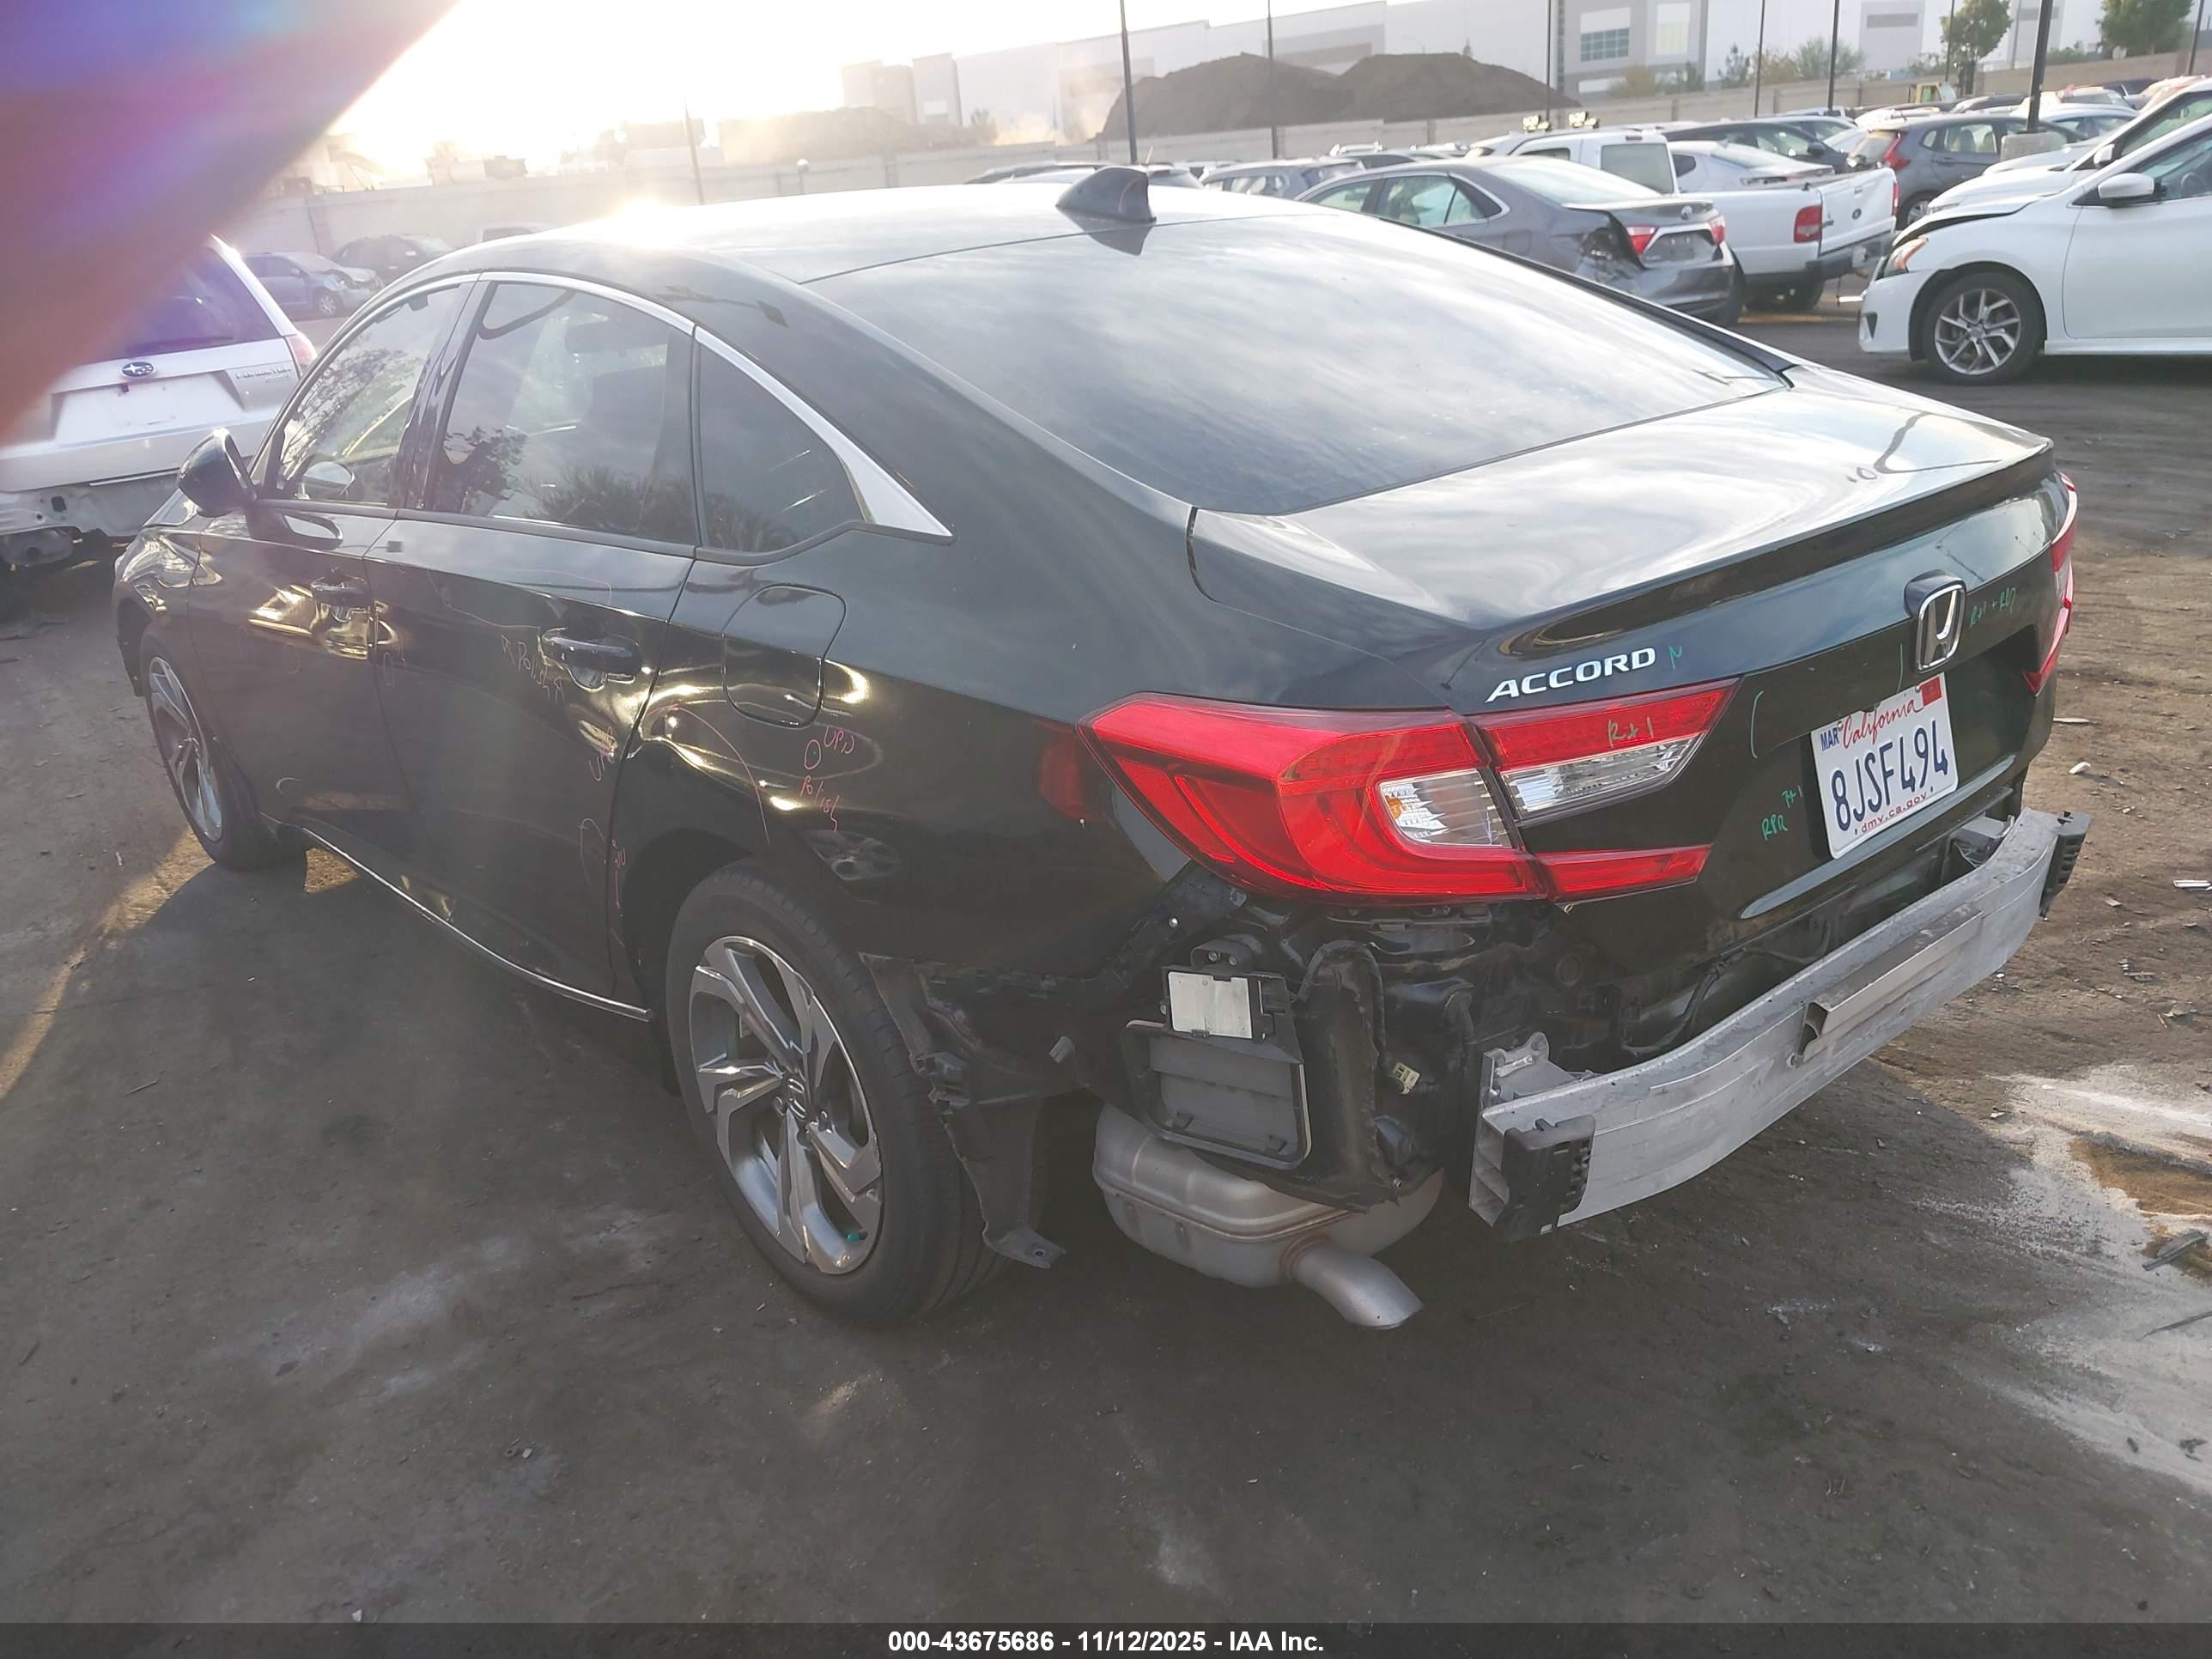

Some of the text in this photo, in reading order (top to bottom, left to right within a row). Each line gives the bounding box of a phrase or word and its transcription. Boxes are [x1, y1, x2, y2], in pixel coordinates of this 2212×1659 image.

[1484, 647, 1656, 704] ACCORD
[1820, 727, 1839, 751] MAR
[1842, 698, 1923, 750] California
[1831, 719, 1948, 831] 8JSF494
[1861, 792, 1928, 833] dmv.ca.gov
